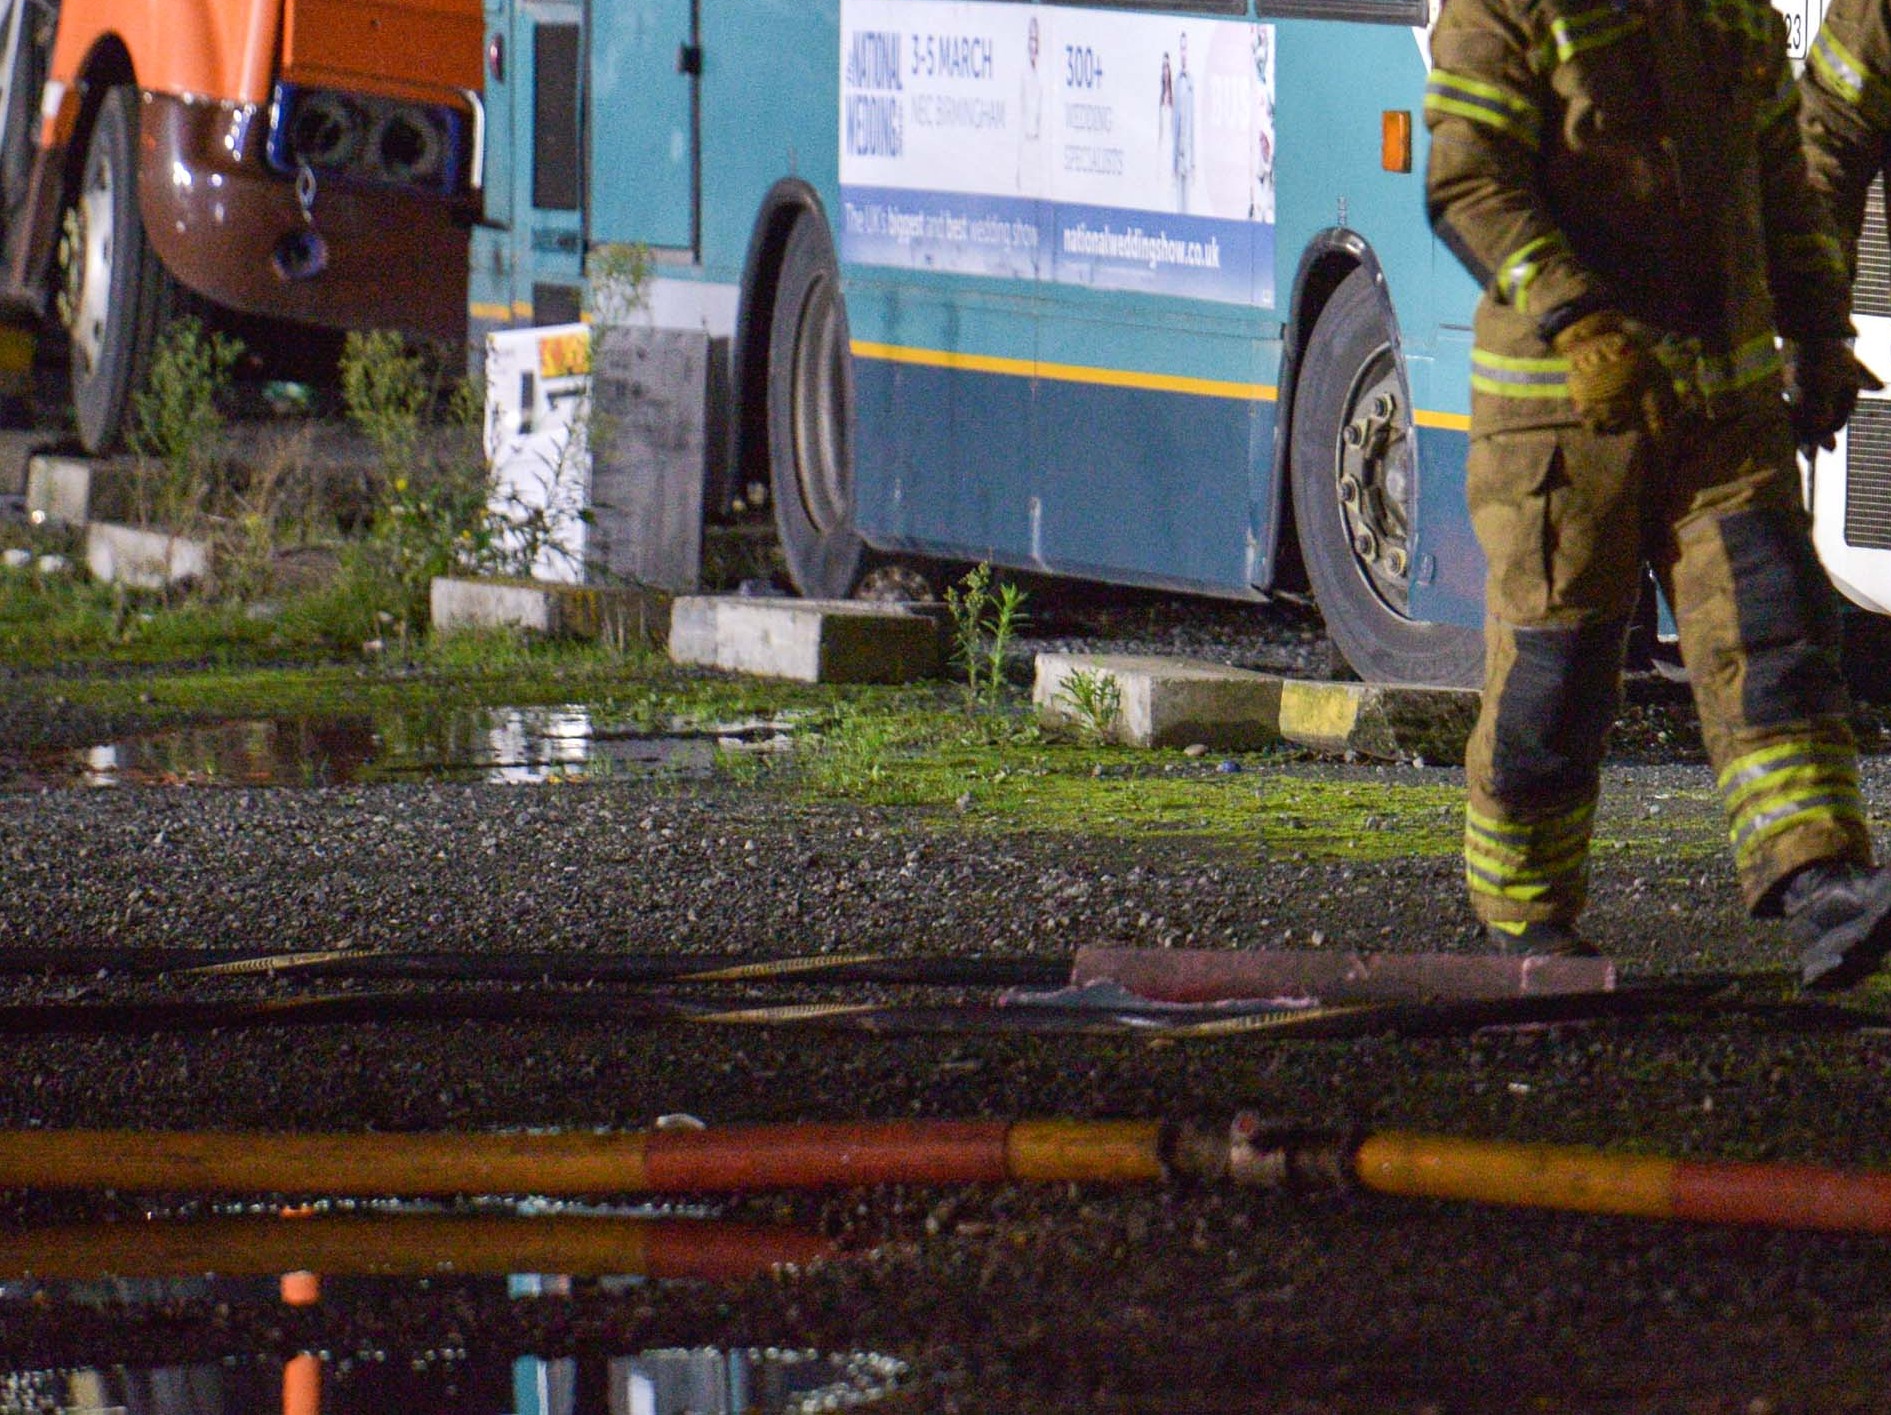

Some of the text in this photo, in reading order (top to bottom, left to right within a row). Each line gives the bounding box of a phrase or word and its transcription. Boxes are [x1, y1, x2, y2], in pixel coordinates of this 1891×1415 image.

[912, 34, 993, 79] 3-5 MARCH
[1066, 45, 1103, 89] 300+
[1063, 222, 1221, 269] nationalweddingshow.co.uk
